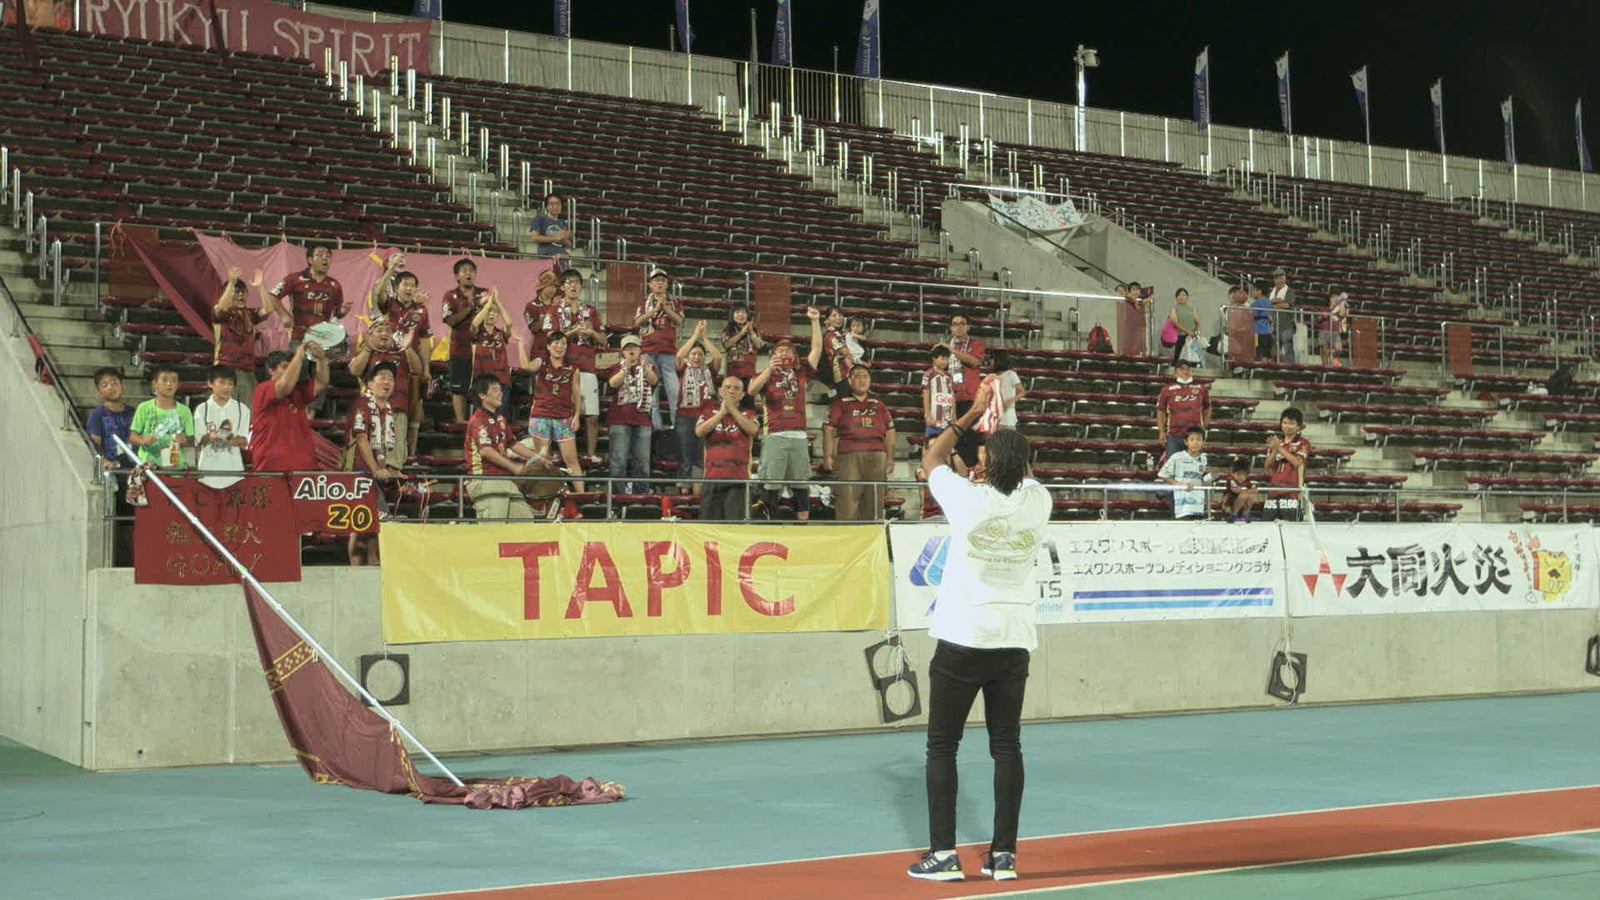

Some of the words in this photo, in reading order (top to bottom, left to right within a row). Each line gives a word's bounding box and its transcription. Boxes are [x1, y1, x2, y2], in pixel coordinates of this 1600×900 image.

[273, 18, 421, 77] SPIRIT
[861, 417, 873, 428] 12
[293, 475, 373, 500] Aio.F
[327, 503, 373, 531] 20
[498, 540, 796, 621] TAPIC
[1346, 543, 1513, 599] 大同火災
